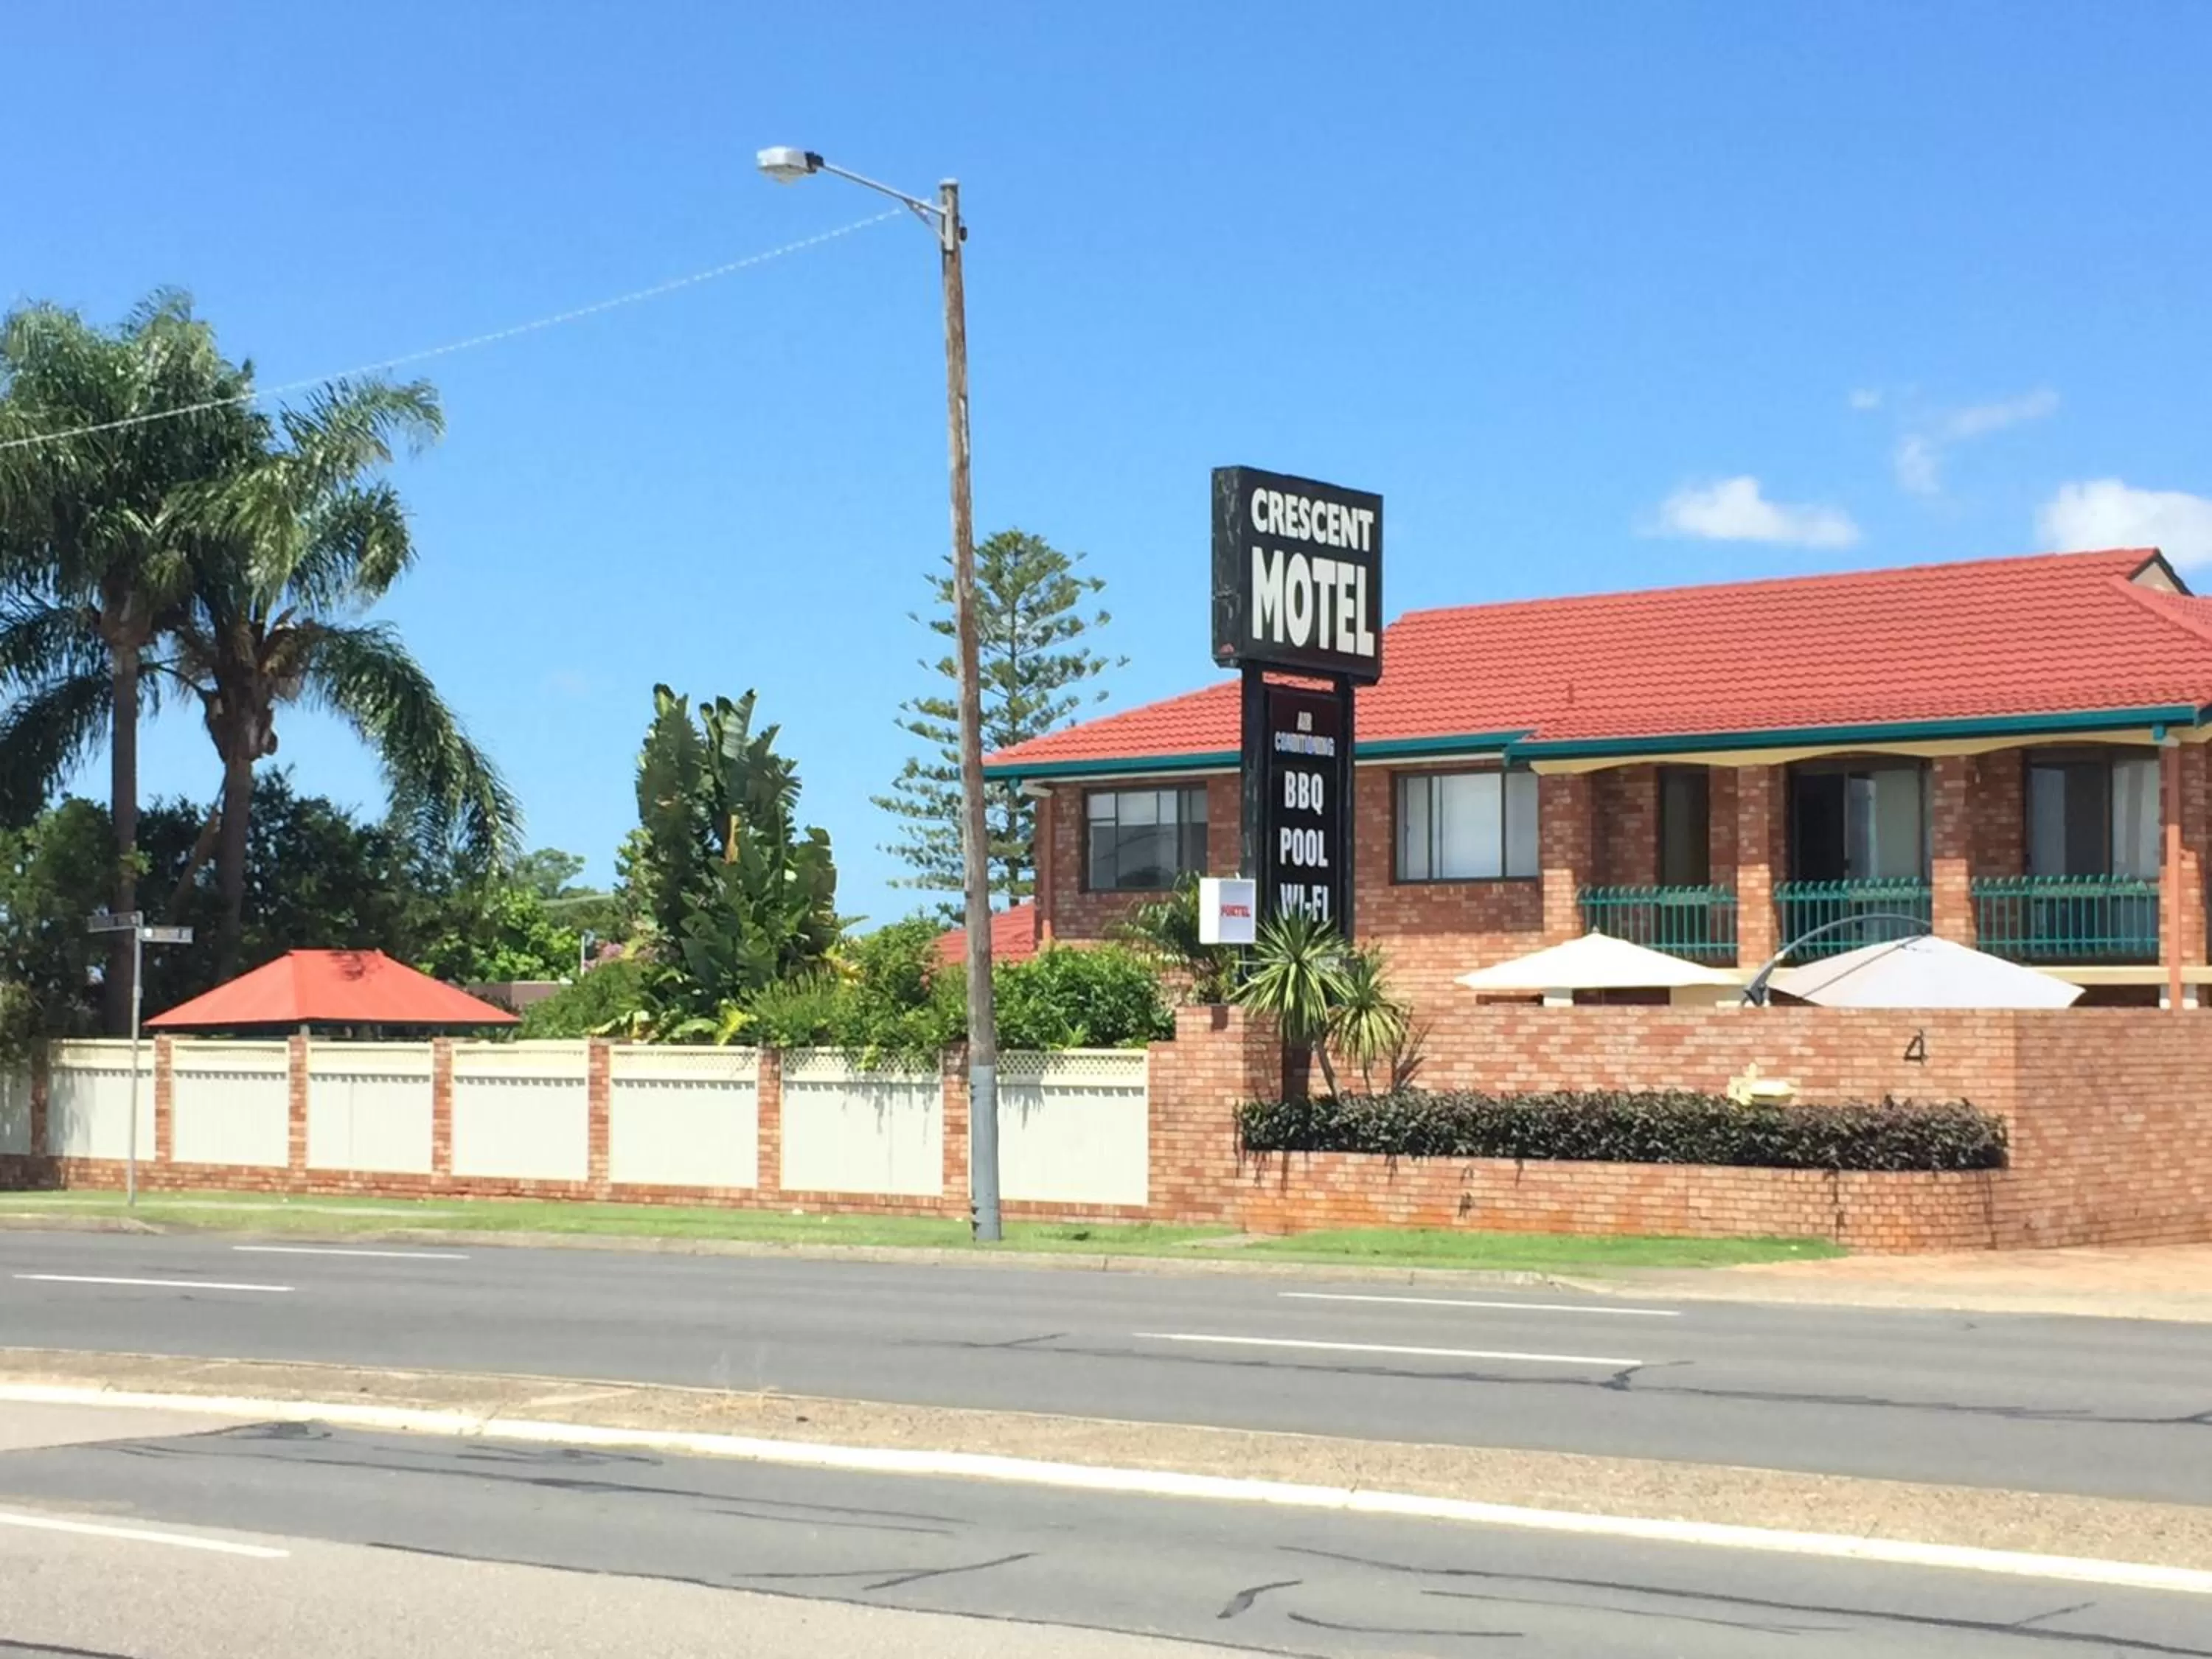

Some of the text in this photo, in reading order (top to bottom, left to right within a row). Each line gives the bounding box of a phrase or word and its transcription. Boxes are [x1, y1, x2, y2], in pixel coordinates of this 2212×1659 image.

[1251, 487, 1374, 552] CRESCENT
[1251, 546, 1375, 658] MOTEL
[1284, 771, 1324, 815] BBQ
[1279, 827, 1329, 868] POOL
[1903, 1029, 1929, 1066] 4
